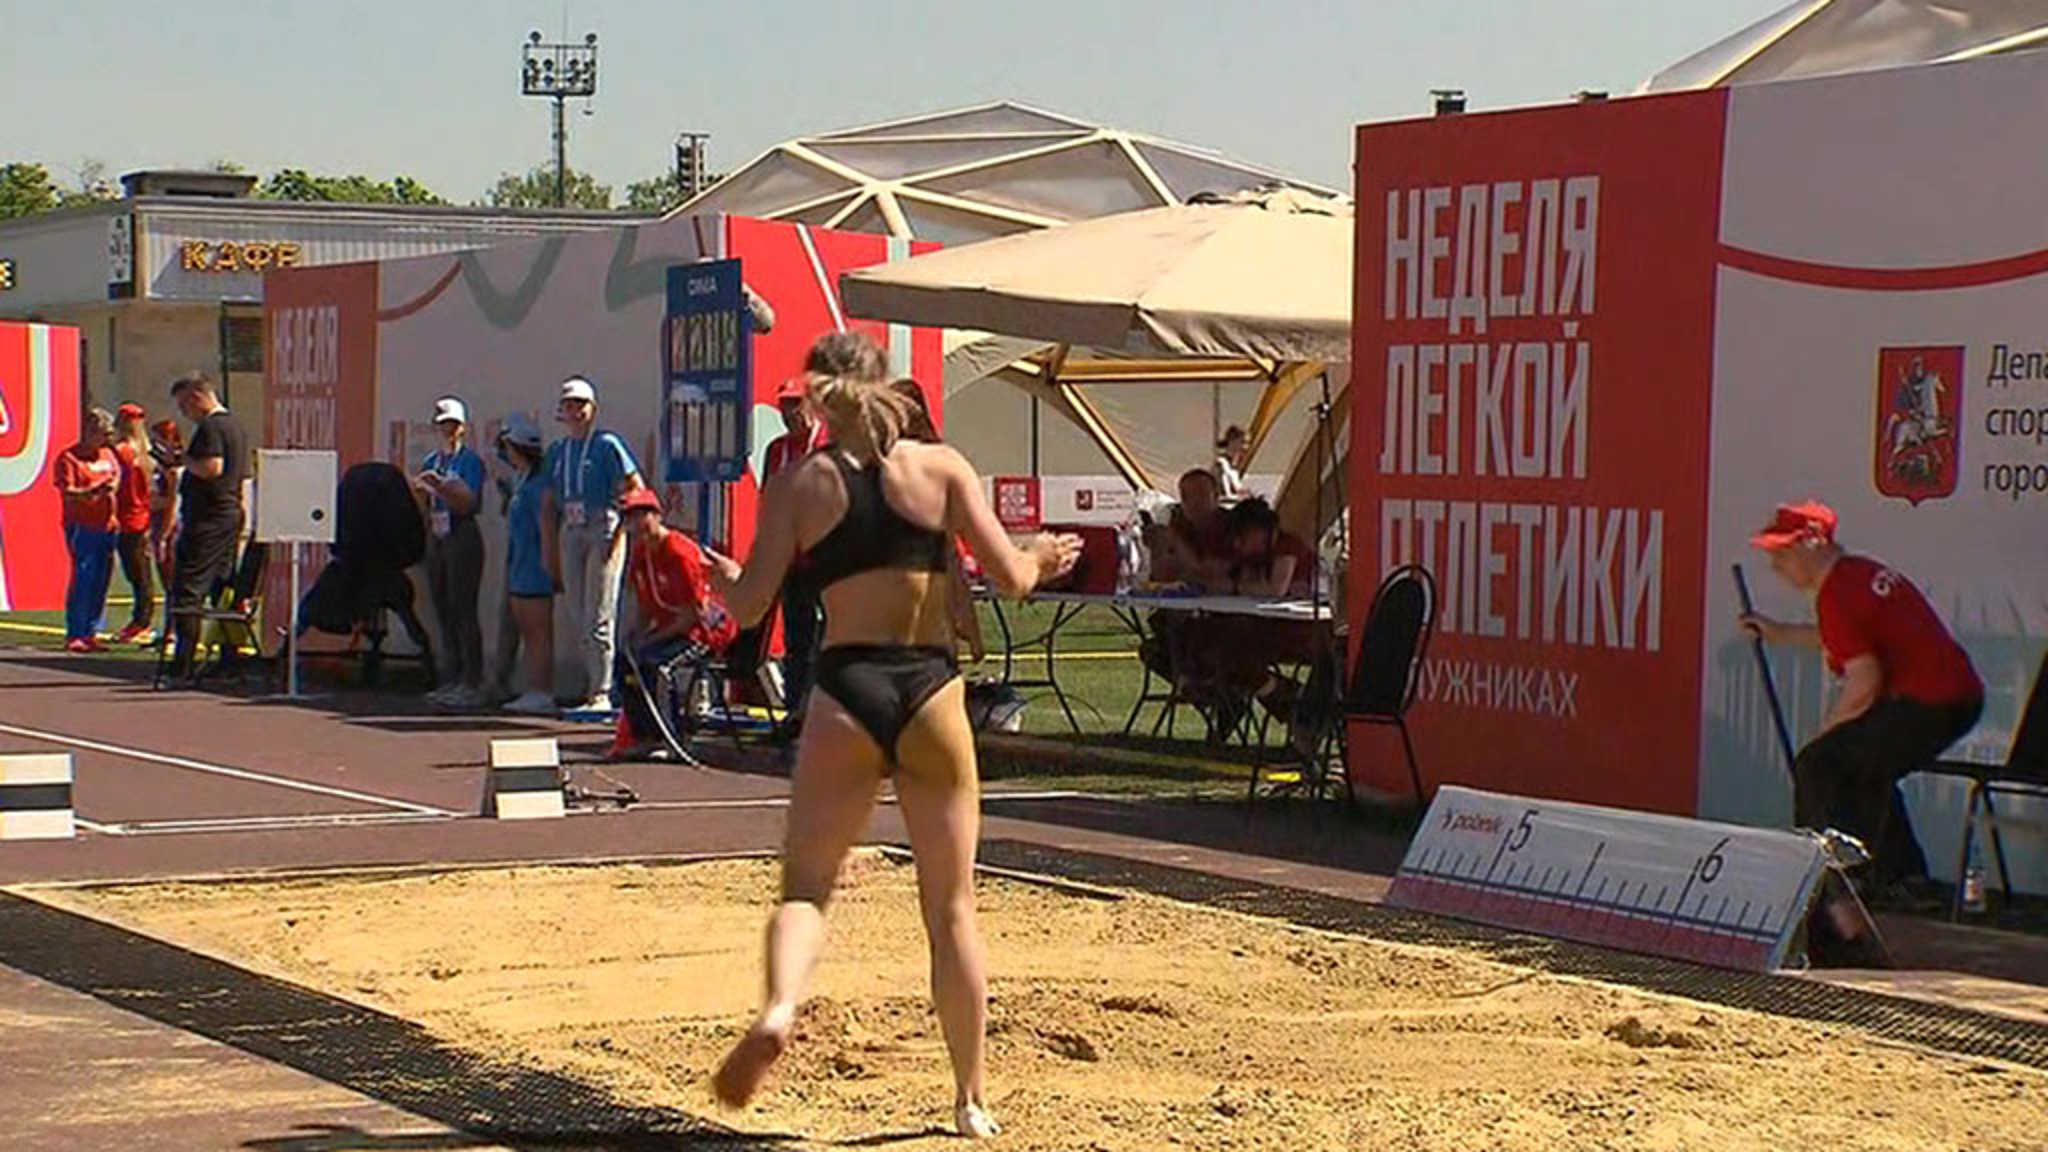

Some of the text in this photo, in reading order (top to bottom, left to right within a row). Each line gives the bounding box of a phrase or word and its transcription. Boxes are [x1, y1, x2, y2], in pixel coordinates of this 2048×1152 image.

[181, 240, 300, 271] КАФЕ
[1384, 176, 1600, 335] НЕДЕЛЯ
[1379, 321, 1590, 479] ЛЕГКОЙ
[1509, 810, 1539, 851] 5
[1701, 837, 1731, 884] 6
